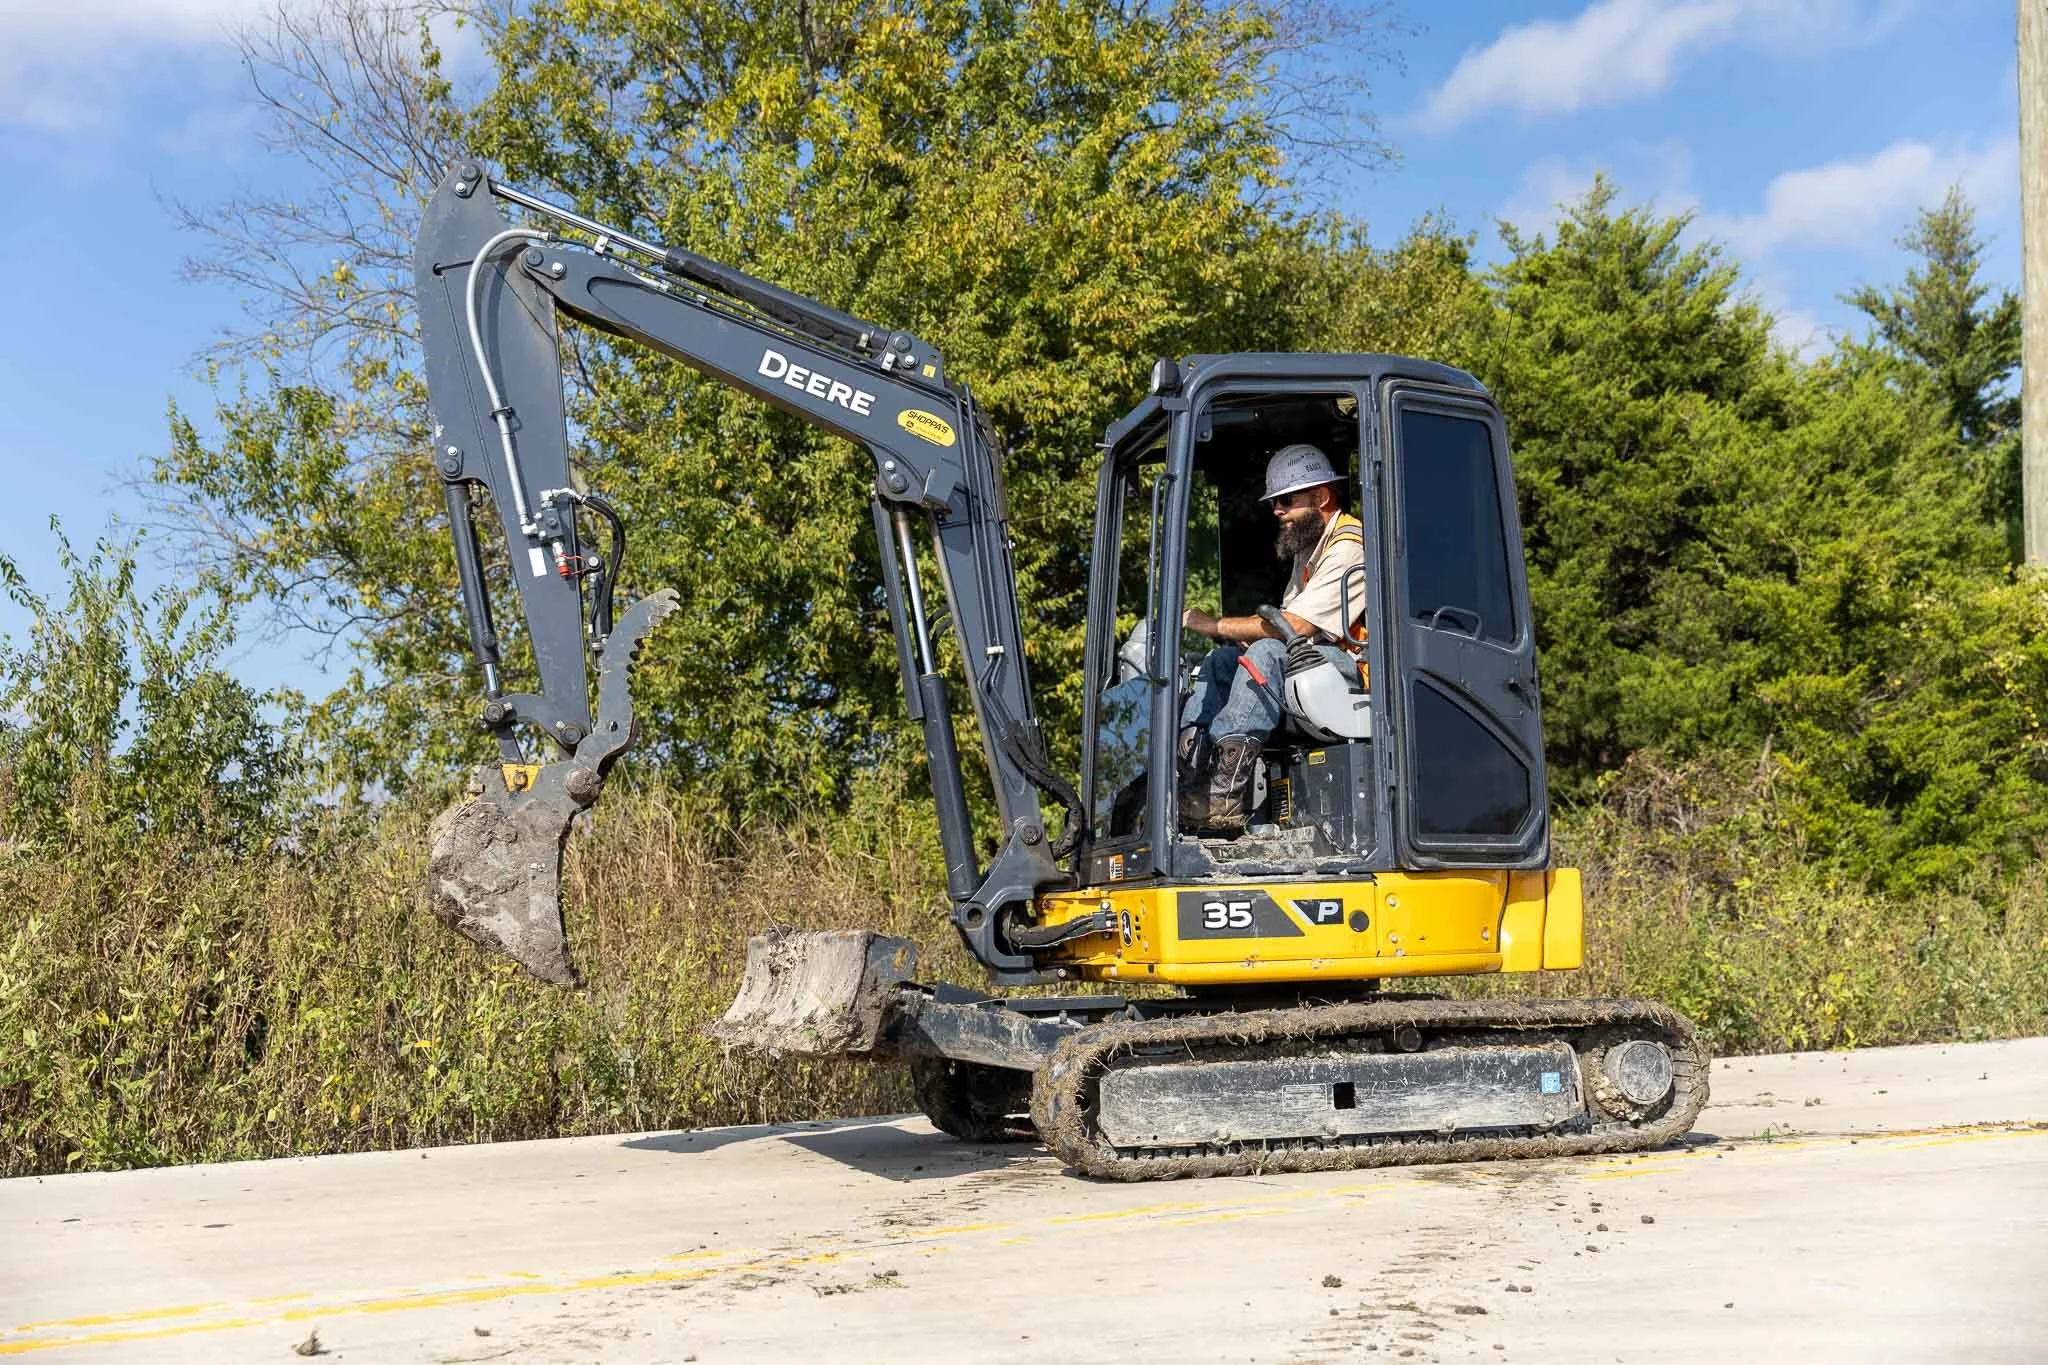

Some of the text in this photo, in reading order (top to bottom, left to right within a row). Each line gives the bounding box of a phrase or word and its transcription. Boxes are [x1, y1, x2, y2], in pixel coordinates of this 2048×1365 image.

[758, 349, 876, 416] DEERE
[907, 411, 950, 434] SHOPPA'S
[1203, 901, 1253, 928] 35
[1317, 901, 1339, 922] P
